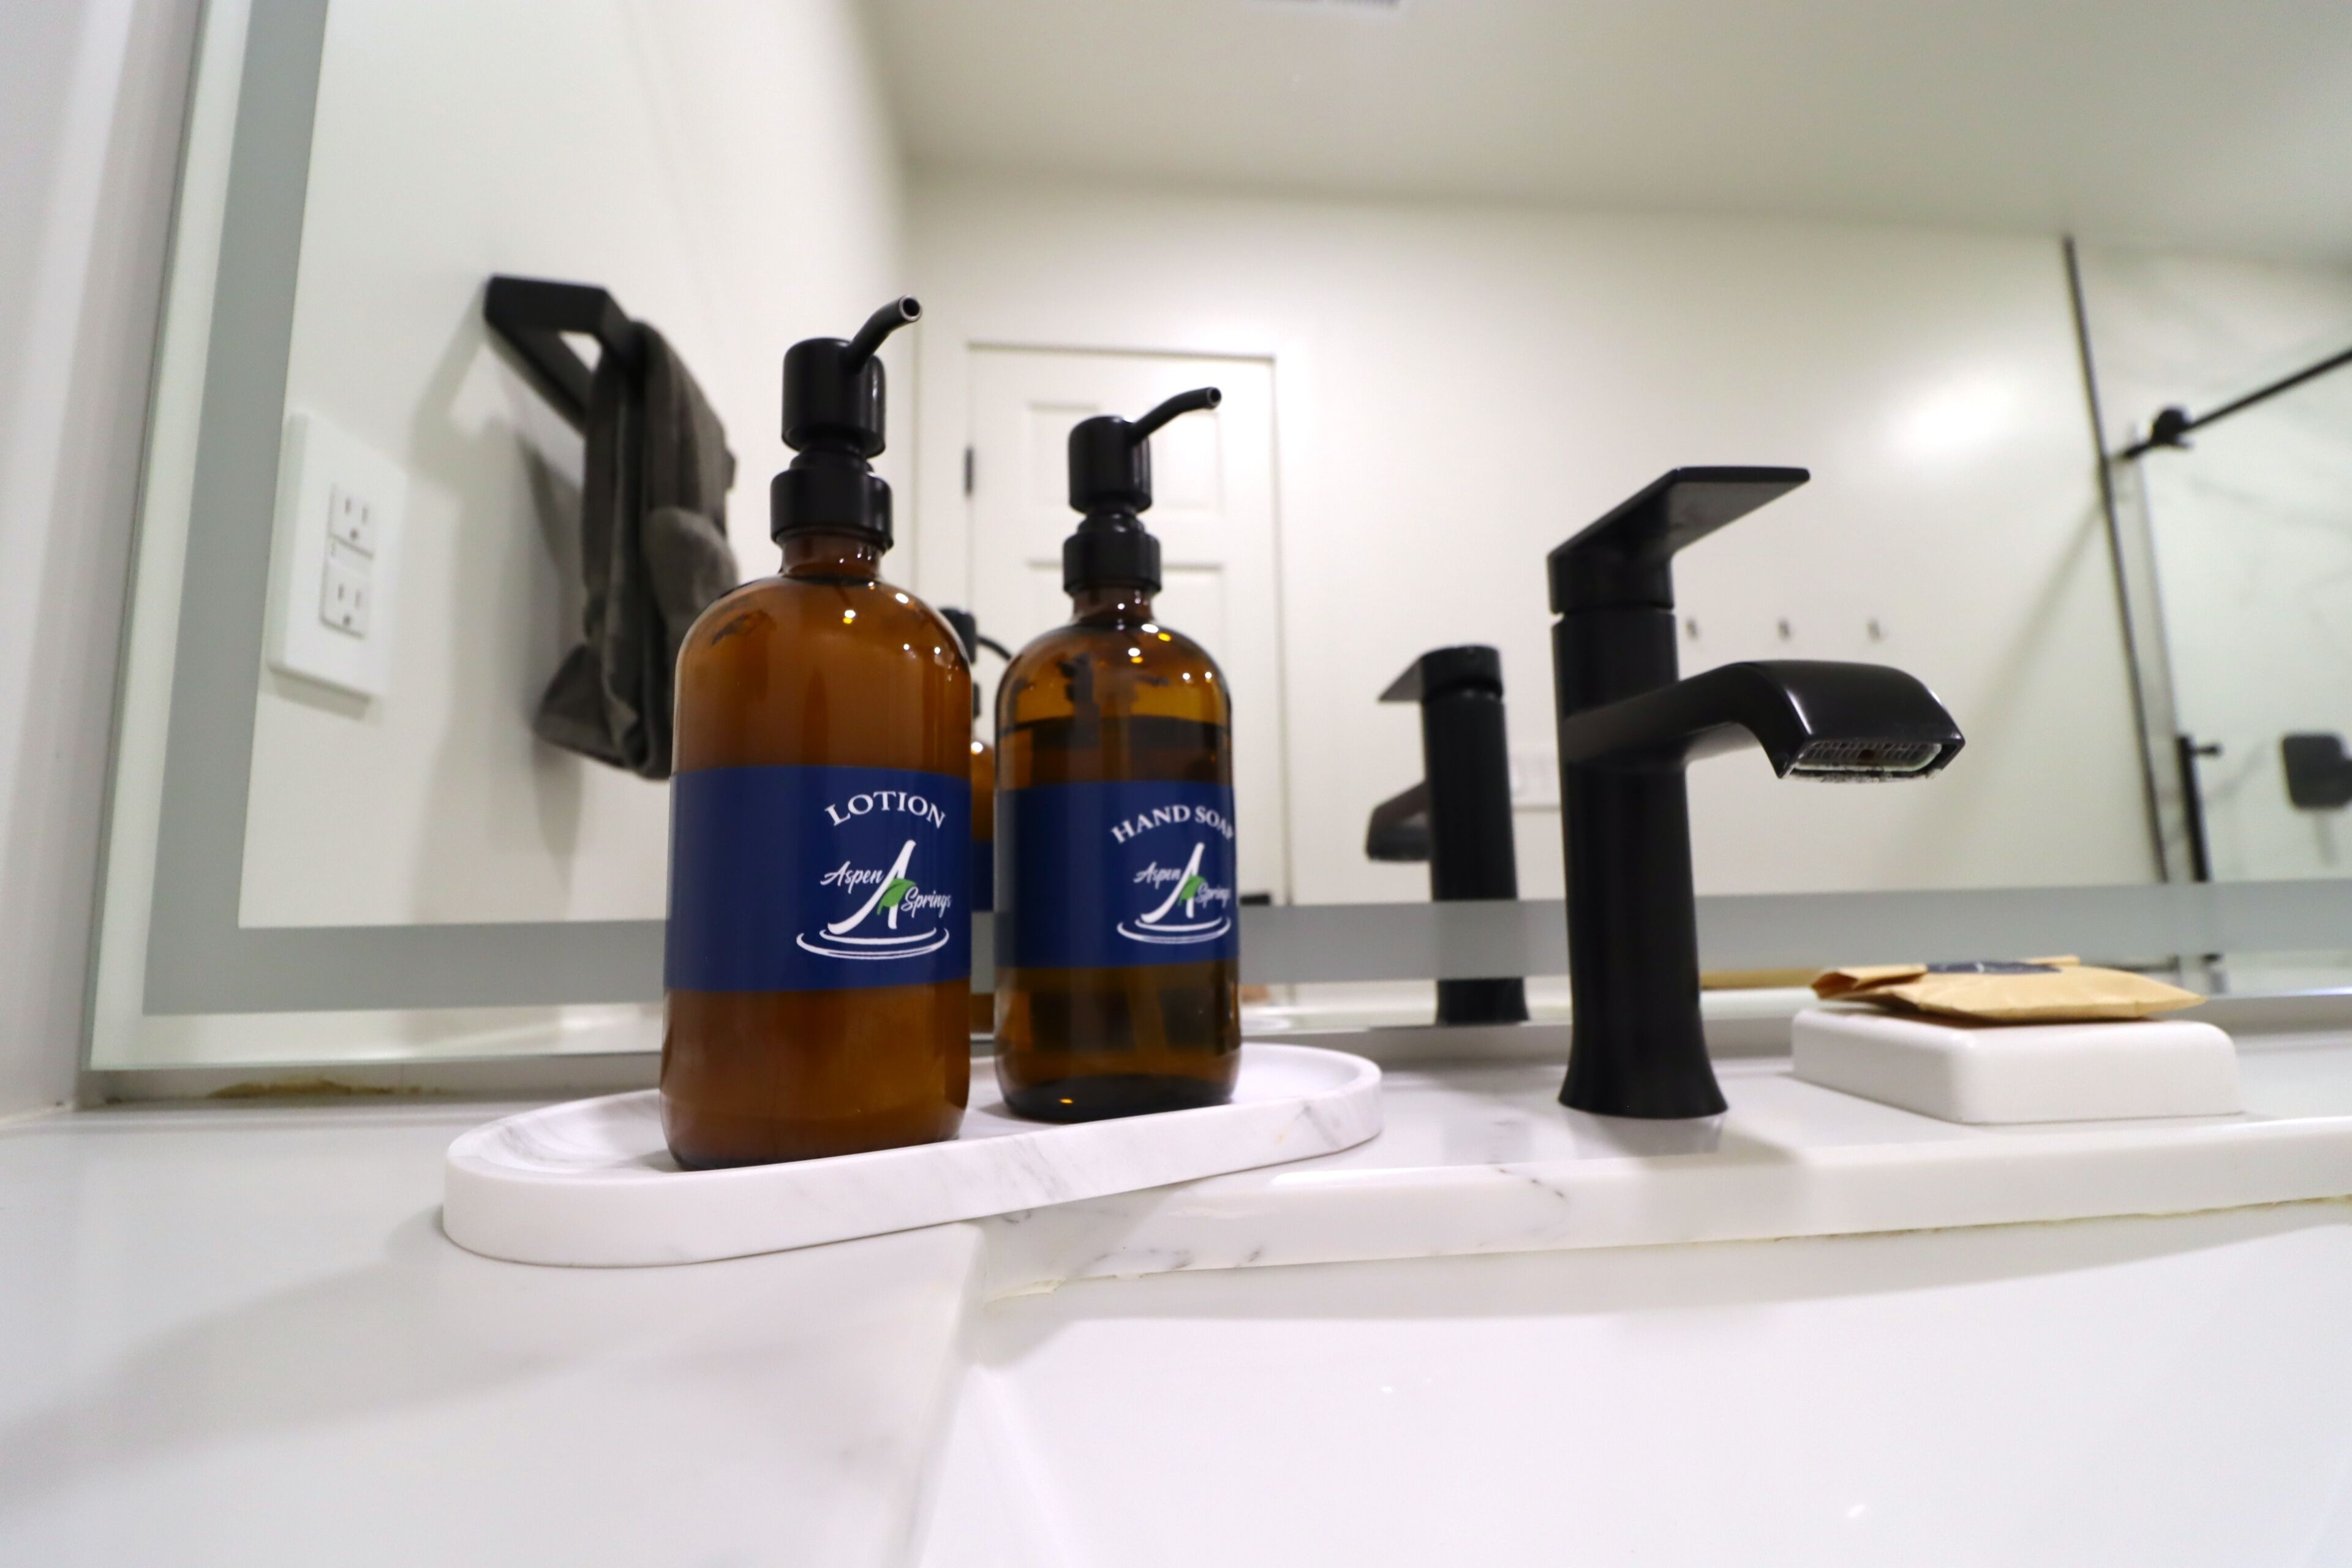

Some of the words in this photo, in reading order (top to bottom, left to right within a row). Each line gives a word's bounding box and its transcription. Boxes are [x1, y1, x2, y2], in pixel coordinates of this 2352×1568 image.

[824, 791, 945, 829] LOTION
[1110, 804, 1191, 844] HAND
[820, 861, 883, 894] Aspen
[900, 886, 952, 918] Springs
[1133, 861, 1181, 889] Aspen
